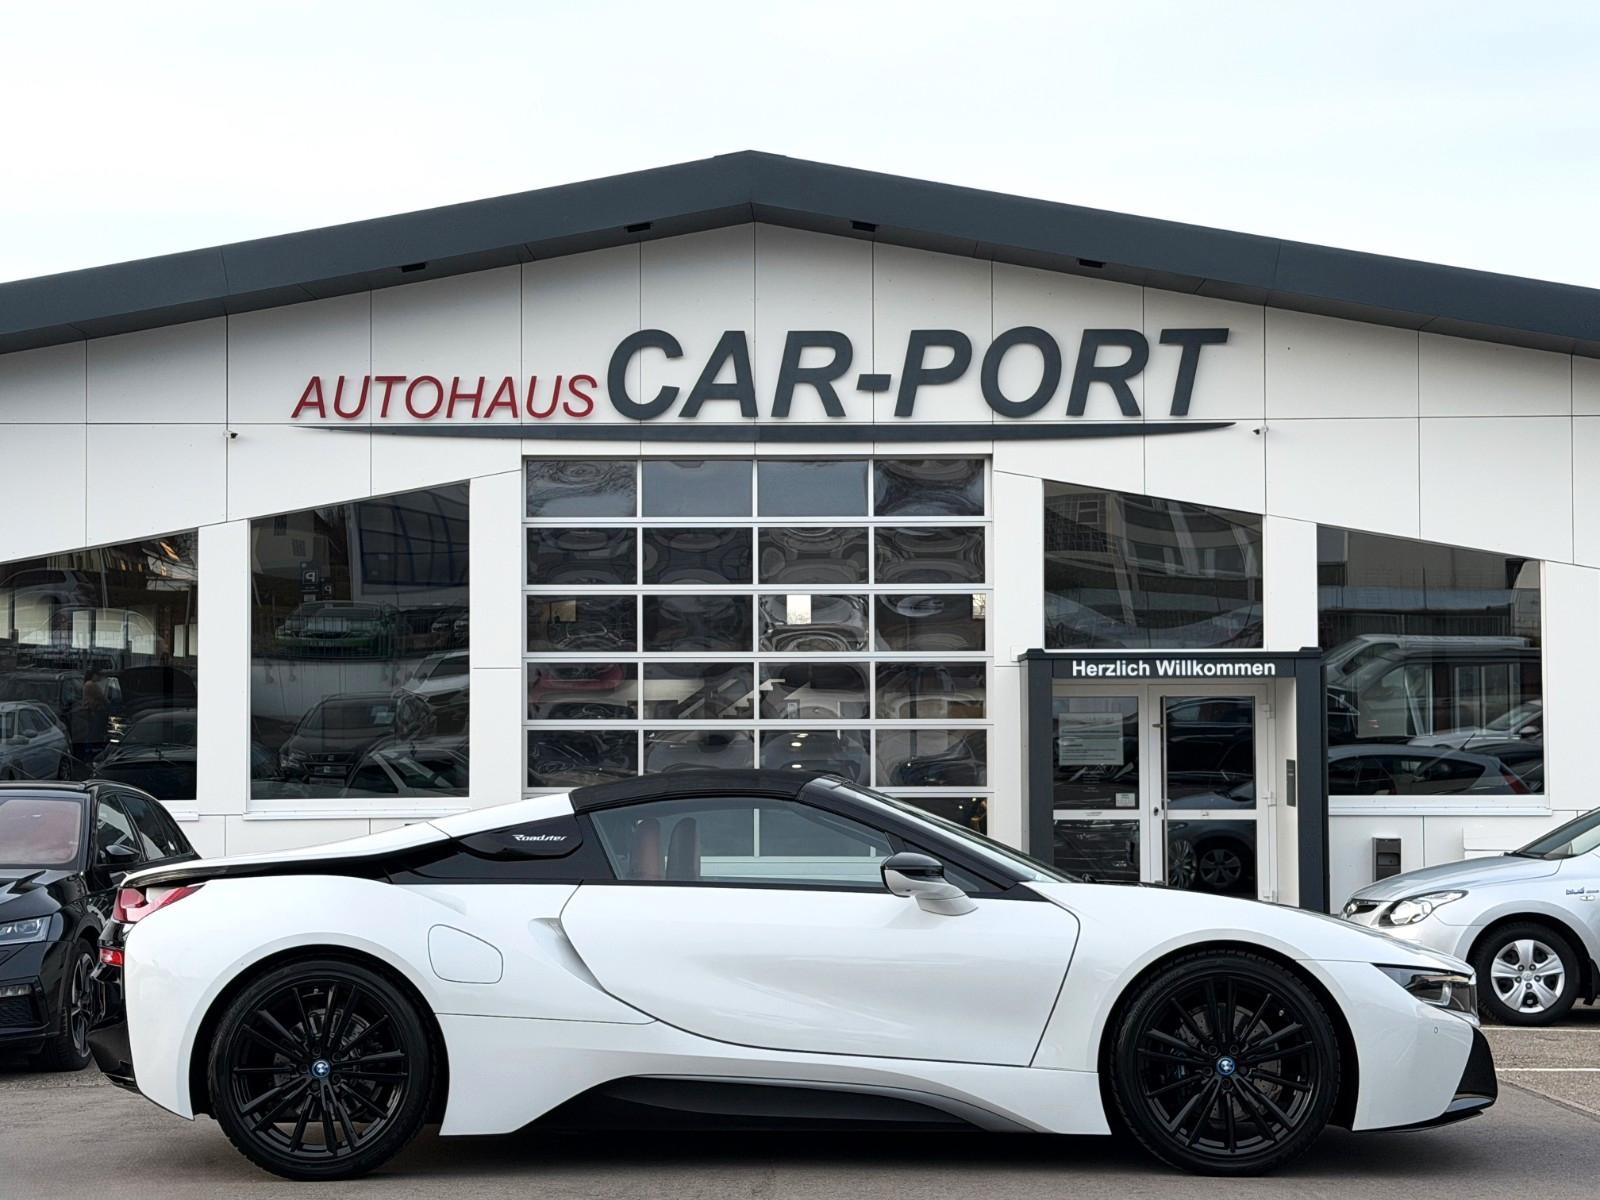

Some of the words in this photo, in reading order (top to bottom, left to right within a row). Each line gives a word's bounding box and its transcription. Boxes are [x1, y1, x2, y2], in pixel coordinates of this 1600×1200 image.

[291, 374, 598, 419] AUTOHAUS
[606, 326, 1230, 421] CAR-PORT
[1072, 659, 1150, 676] Herzlich
[1155, 659, 1276, 676] Willkommen
